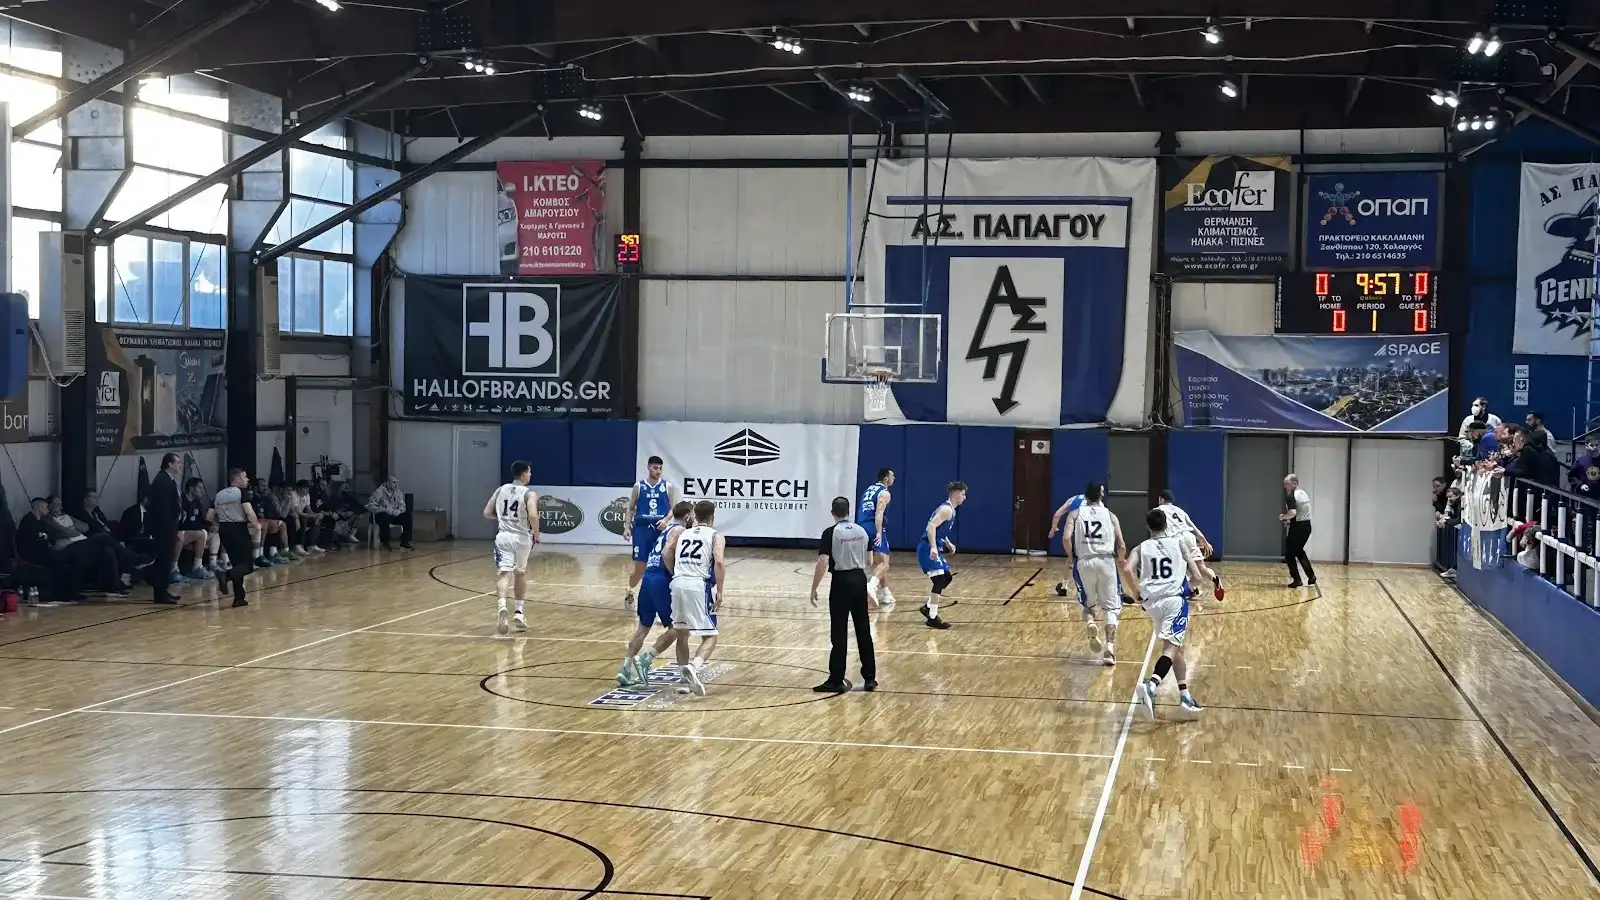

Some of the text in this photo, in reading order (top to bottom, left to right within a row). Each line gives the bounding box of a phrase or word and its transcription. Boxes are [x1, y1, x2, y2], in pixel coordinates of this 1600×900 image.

[1184, 172, 1267, 207] Ecofer
[1572, 174, 1600, 191] ΠΑ
[533, 198, 570, 207] ΚΟΜΒΟΣ
[524, 208, 580, 218] ΑΜΑΡΟΥΣΙΟΥ
[911, 213, 1106, 240] Α.Σ. ΠΑΠΑΓΟΥ
[1204, 217, 1253, 226] ΘΕΡΜΑΝΣΗ
[1198, 227, 1258, 236] ΚΛΙΜΑΤΙΣΜΟΣ
[1191, 237, 1265, 246] ΗΛΙΑΚΑ ΠΙΣΙΝΕΣ
[523, 245, 582, 256] 210 6101220
[617, 244, 639, 260] 23
[1184, 262, 1258, 270] www.ecofer.com.gr
[1315, 272, 1428, 295] 0 9:57 0
[1333, 310, 1427, 331] 0 1 0
[469, 291, 554, 369] HB
[1388, 341, 1441, 357] SPACE
[413, 378, 611, 400] HALLOFBRANDS.GR
[683, 477, 809, 498] EVERTECH
[502, 499, 519, 518] 14
[649, 499, 658, 509] 6
[754, 502, 808, 510] DEVELOPMENT
[538, 510, 568, 520] RETA
[1084, 520, 1102, 539] 12
[680, 539, 703, 560] 22
[1151, 557, 1173, 580] 16
